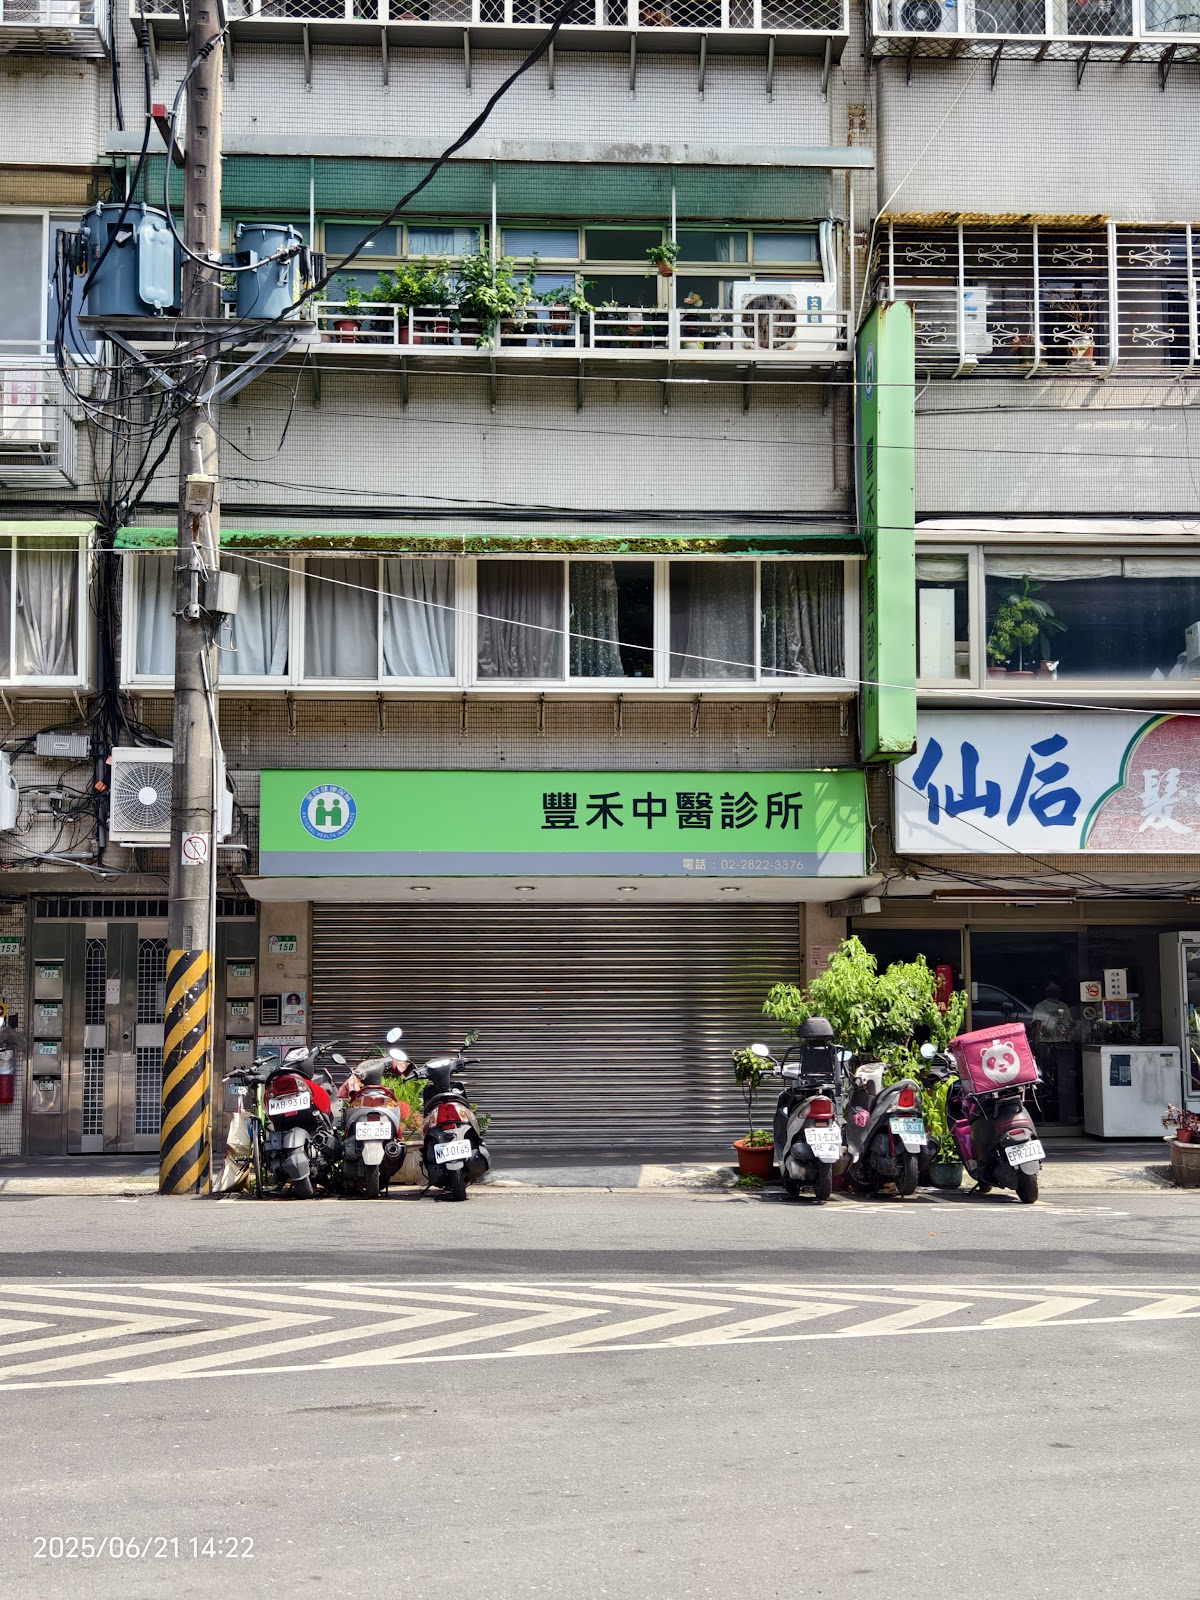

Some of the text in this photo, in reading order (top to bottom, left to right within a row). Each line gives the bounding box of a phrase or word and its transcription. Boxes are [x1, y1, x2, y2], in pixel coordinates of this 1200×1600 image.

[912, 733, 1200, 833] 仙后 髮
[541, 791, 803, 830] 豐禾中醫診所
[720, 859, 804, 870] 02-2822-3376
[1, 944, 17, 953] 152
[278, 943, 294, 951] 150
[1008, 1144, 1043, 1162] EPR-2212
